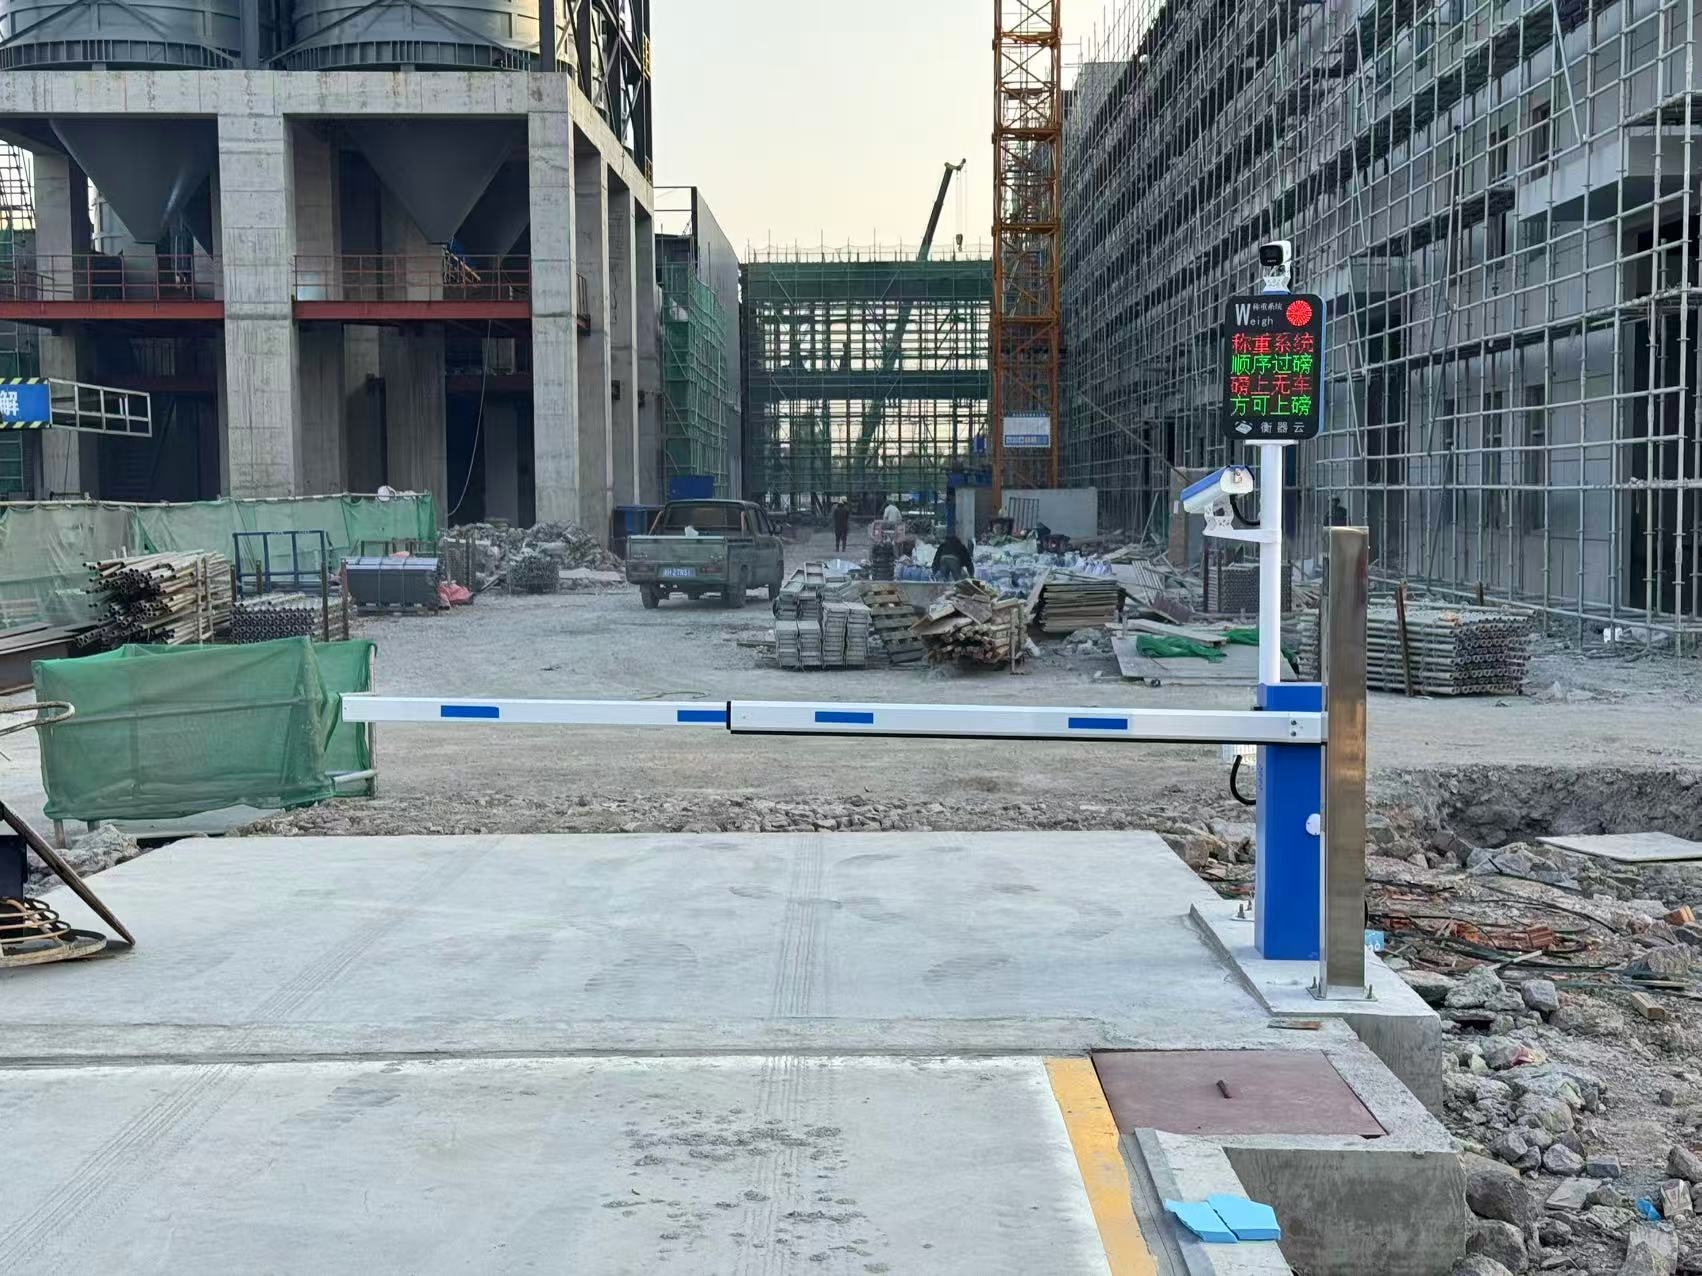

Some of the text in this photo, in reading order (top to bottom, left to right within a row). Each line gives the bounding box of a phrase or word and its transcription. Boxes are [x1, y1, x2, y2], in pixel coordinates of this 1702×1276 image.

[1235, 303, 1274, 327] Weigh
[1231, 332, 1314, 354] 称重系统
[1231, 353, 1313, 375] 顺序过磅
[1230, 373, 1312, 395] 磅上无车
[1230, 394, 1311, 416] 方可上磅
[1260, 421, 1305, 433] 衡器云
